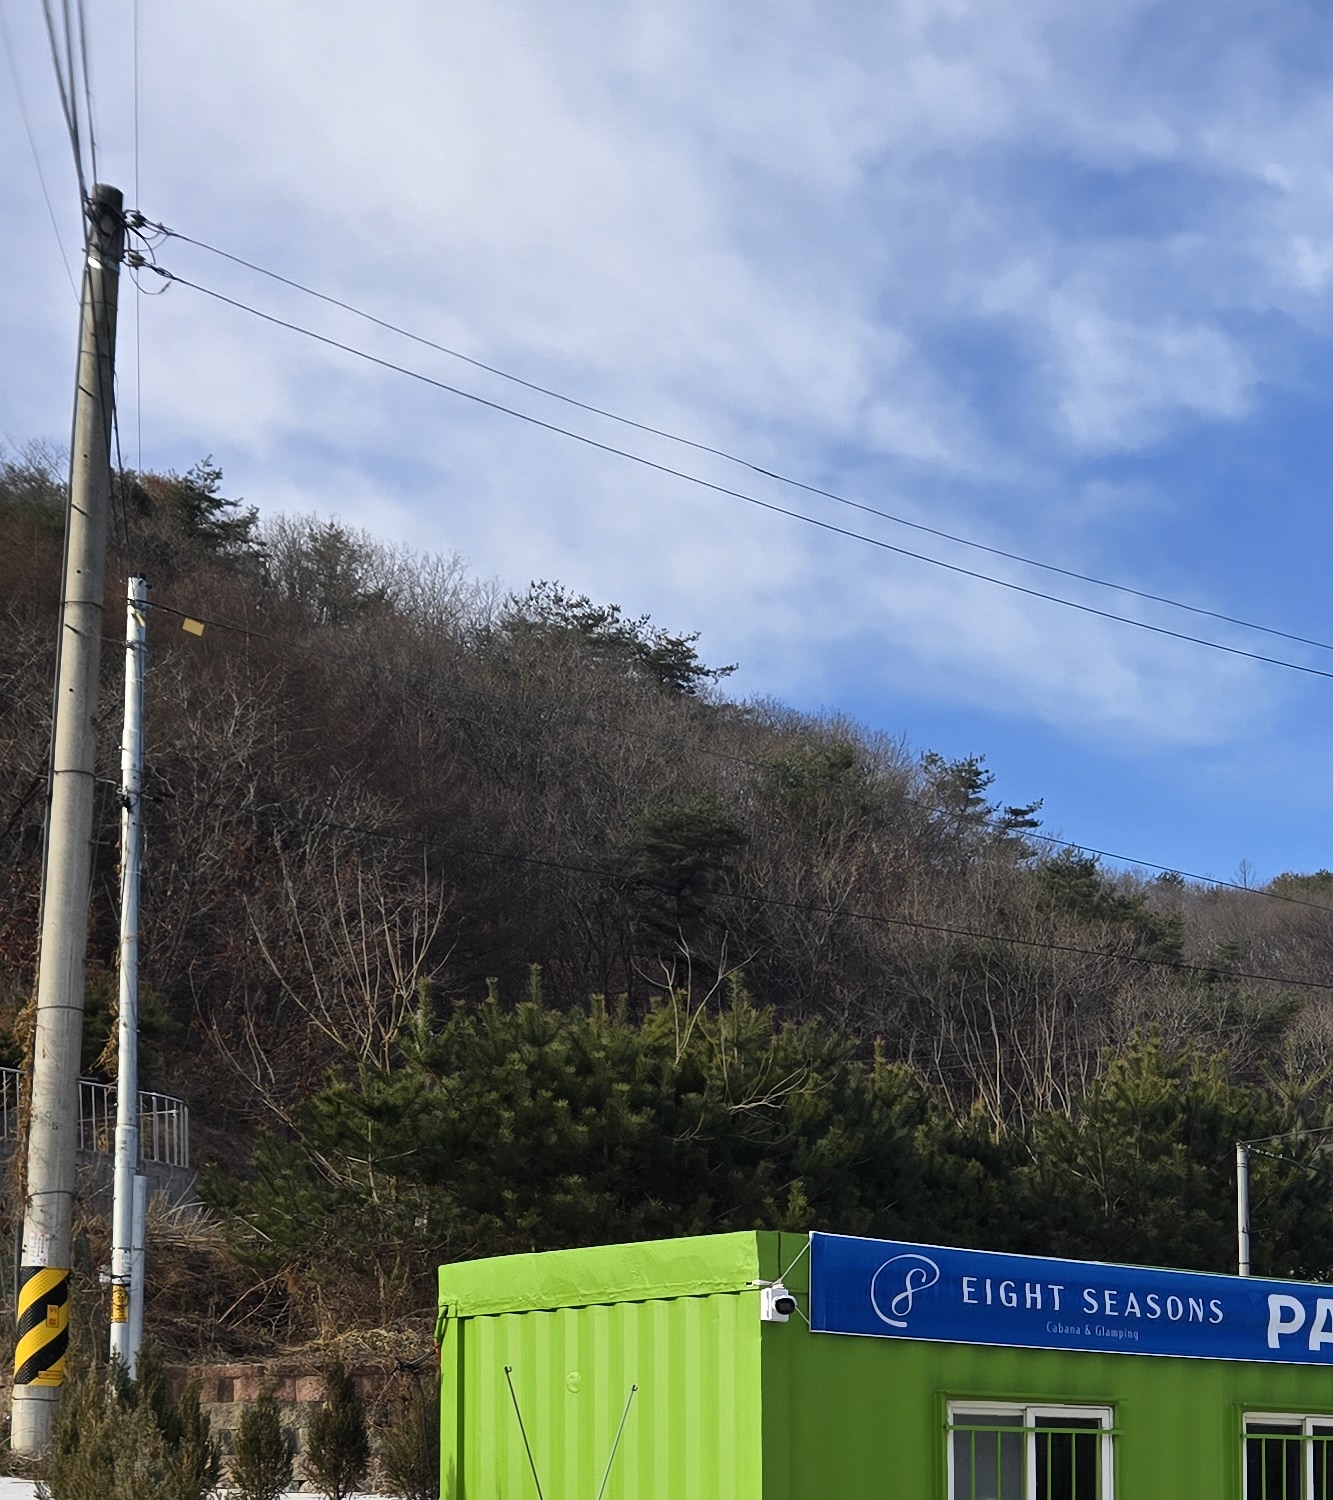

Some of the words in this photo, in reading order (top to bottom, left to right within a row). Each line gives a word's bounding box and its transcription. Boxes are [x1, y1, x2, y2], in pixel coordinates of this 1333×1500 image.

[962, 1276, 1064, 1311] EIGHT
[1082, 1288, 1224, 1324] SEASONS
[1046, 1321, 1081, 1335] Cabana
[1084, 1324, 1091, 1336] &
[1095, 1325, 1139, 1341] Glamping
